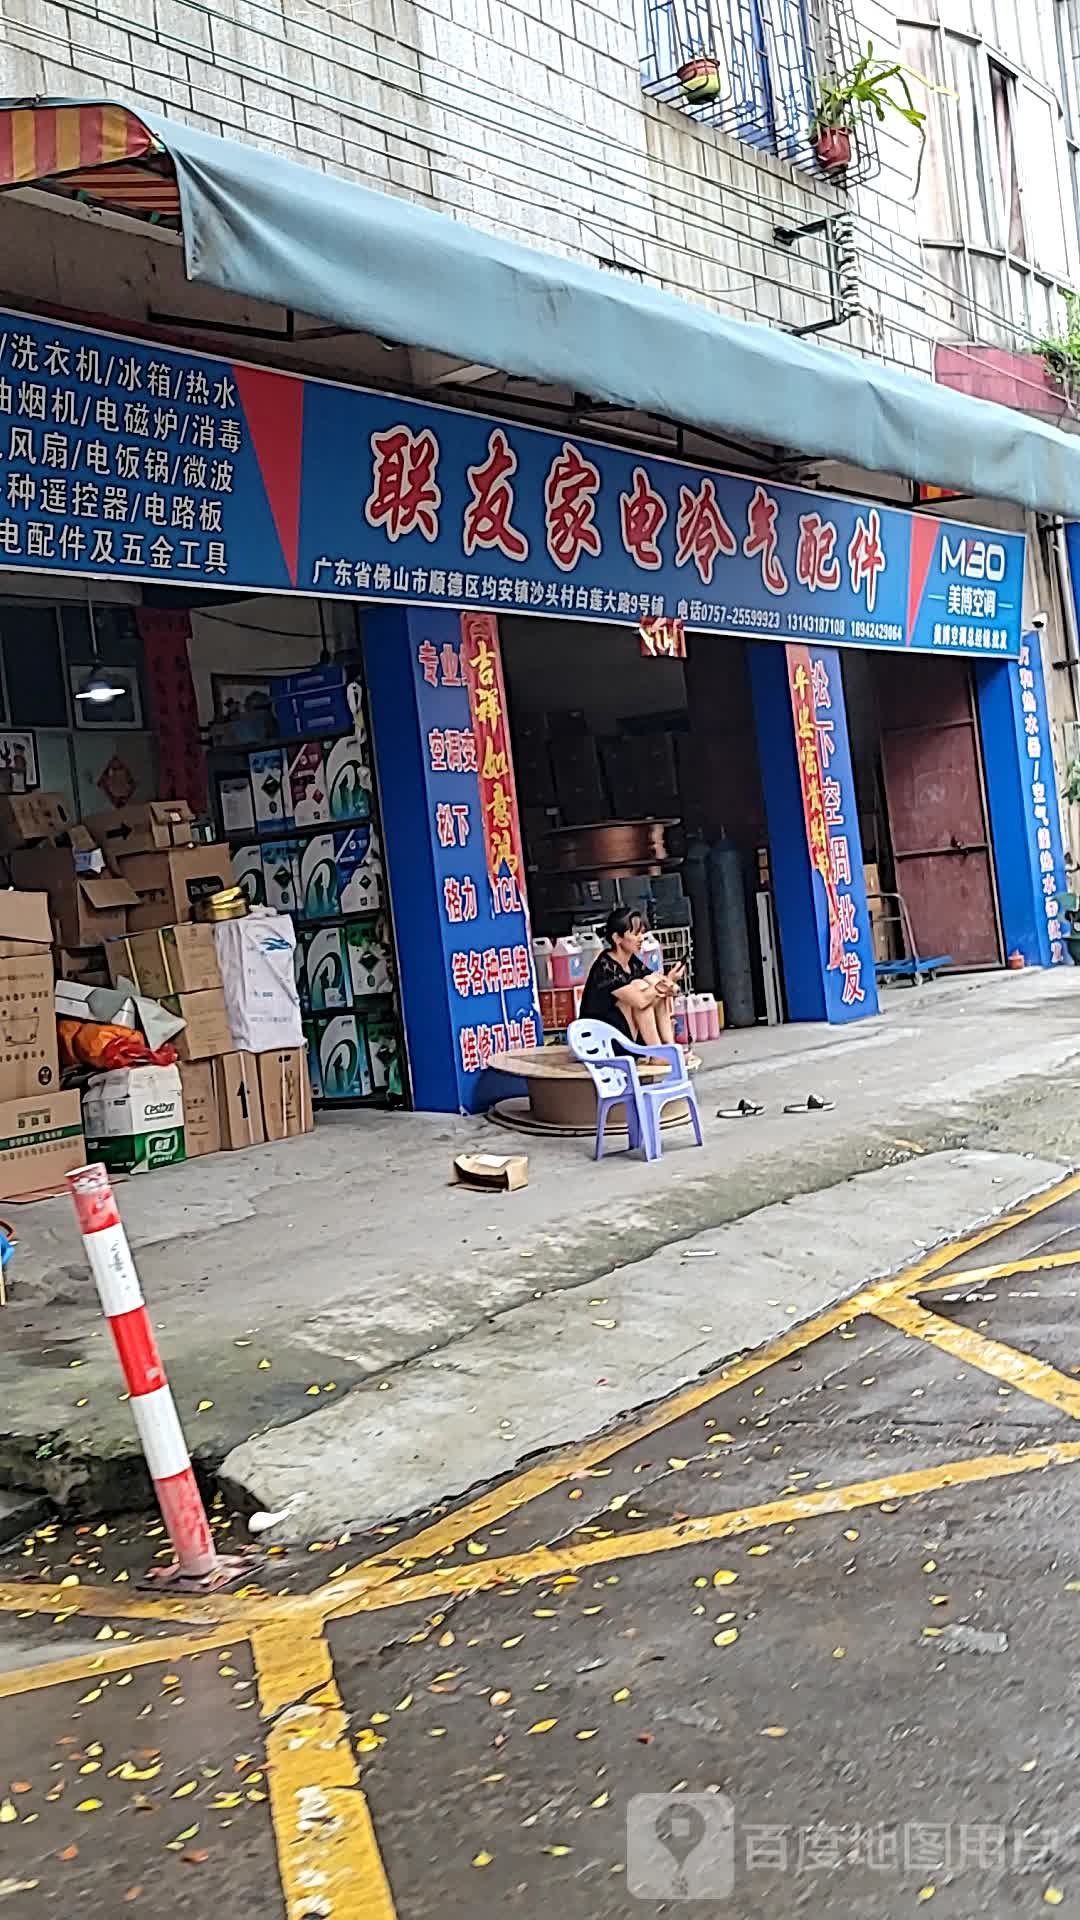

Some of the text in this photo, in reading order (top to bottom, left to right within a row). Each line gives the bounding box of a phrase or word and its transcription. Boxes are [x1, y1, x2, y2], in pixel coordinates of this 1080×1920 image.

[0, 427, 234, 494] 风扇/电饭锅/微波
[0, 473, 223, 533] 种遥控器/电路板
[365, 424, 887, 613] 联友家电冷气配件
[312, 557, 664, 617] 广东省佛山市顺德区均安镇沙头村白莲大路9号铺
[677, 598, 781, 629] 电话0757-25599923
[786, 614, 846, 637] 13143187108
[947, 583, 997, 619] 美博空调
[418, 640, 470, 688] 专业
[436, 802, 470, 848] 松下
[443, 876, 522, 923] 格力 TCL
[452, 944, 531, 998] 等各种品牌
